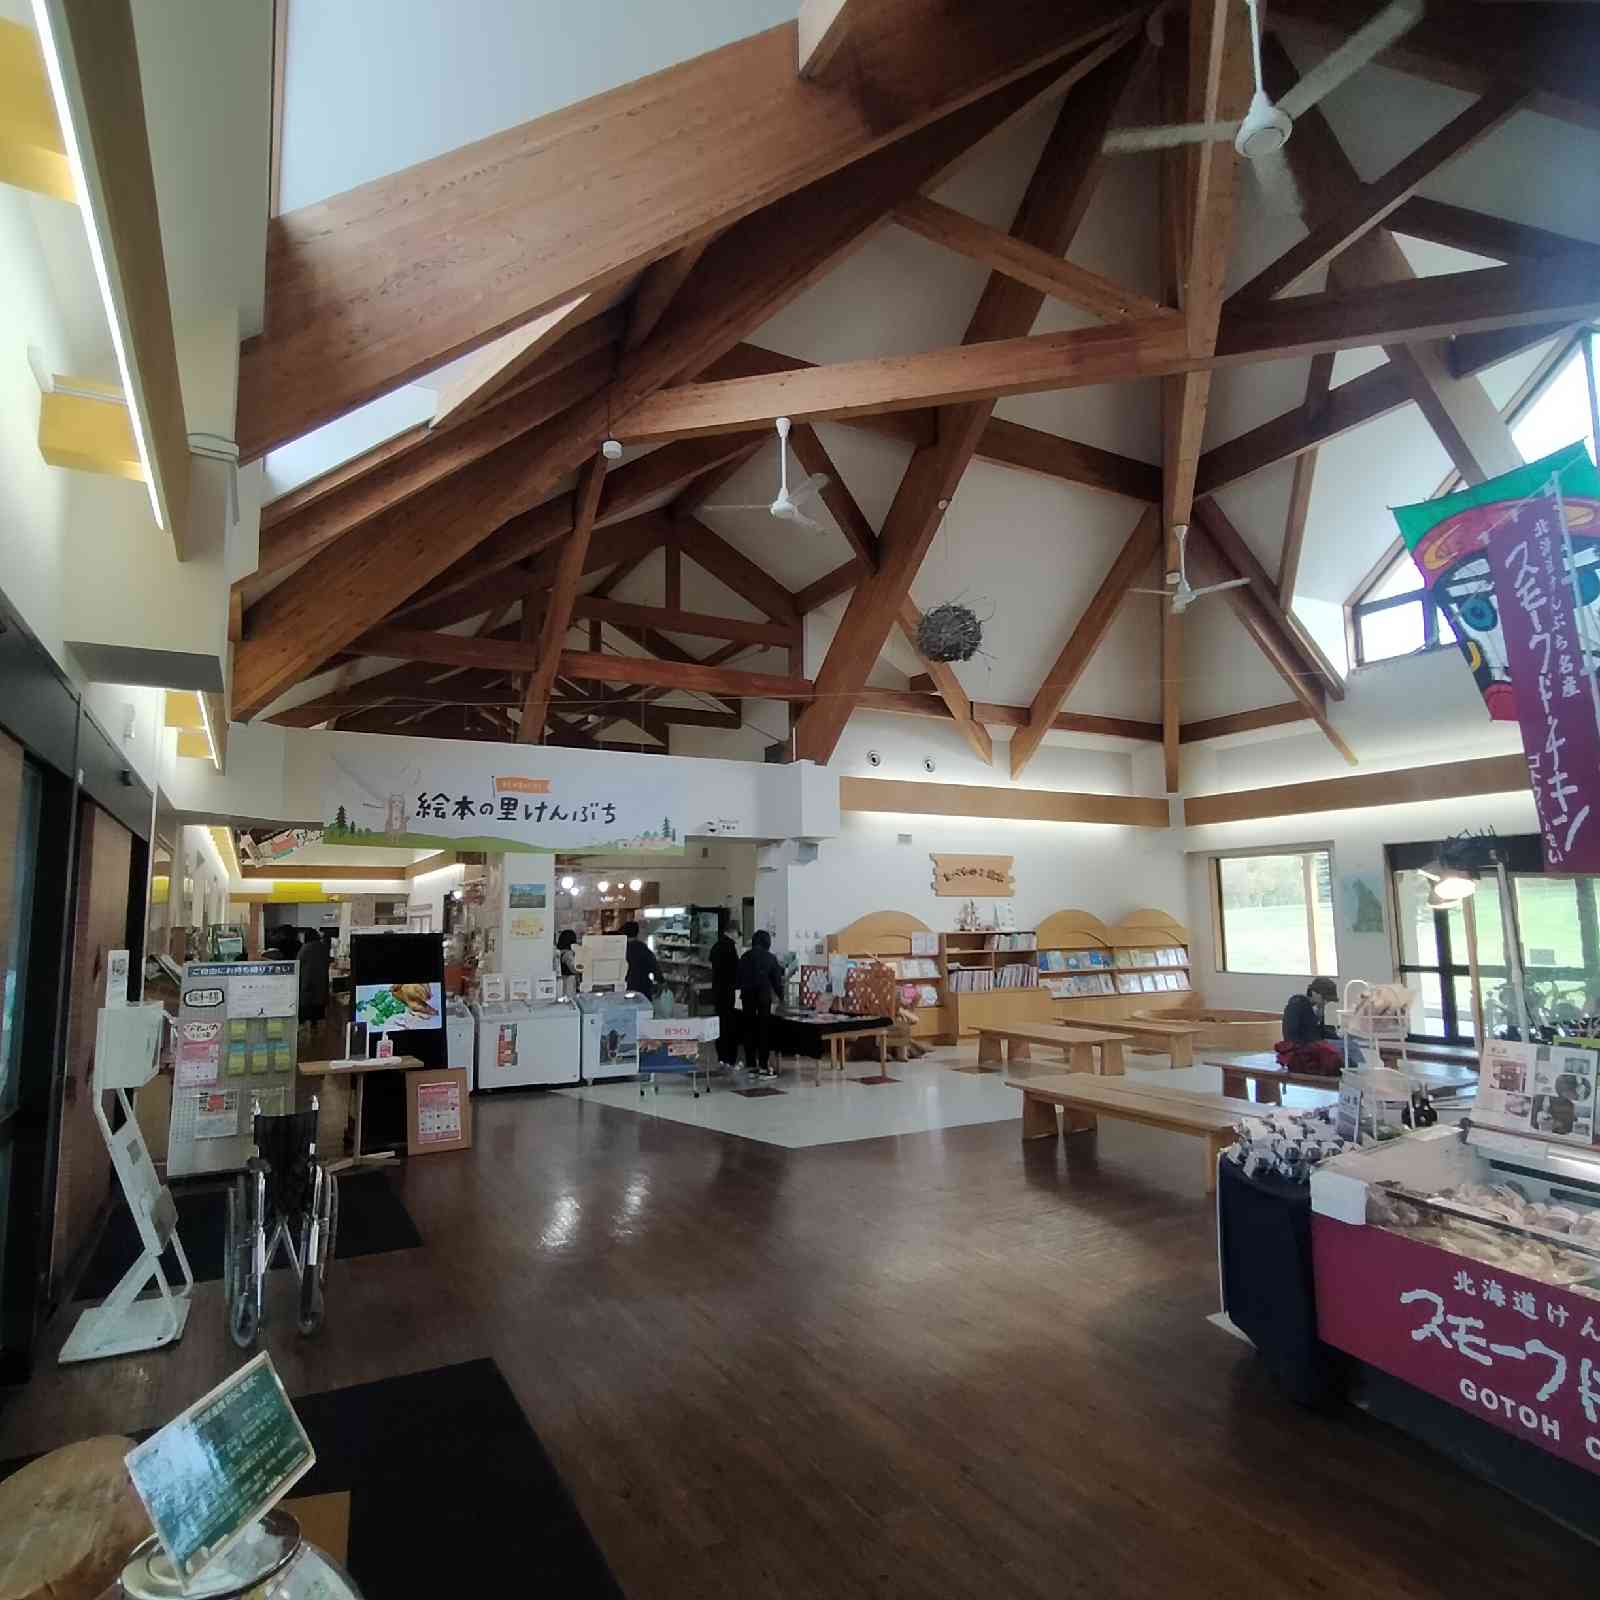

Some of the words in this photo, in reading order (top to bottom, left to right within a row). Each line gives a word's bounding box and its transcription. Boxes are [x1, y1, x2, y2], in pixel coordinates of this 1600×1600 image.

[415, 791, 617, 825] 絵本の里けんぶち
[1459, 1378, 1560, 1440] GOTOH
